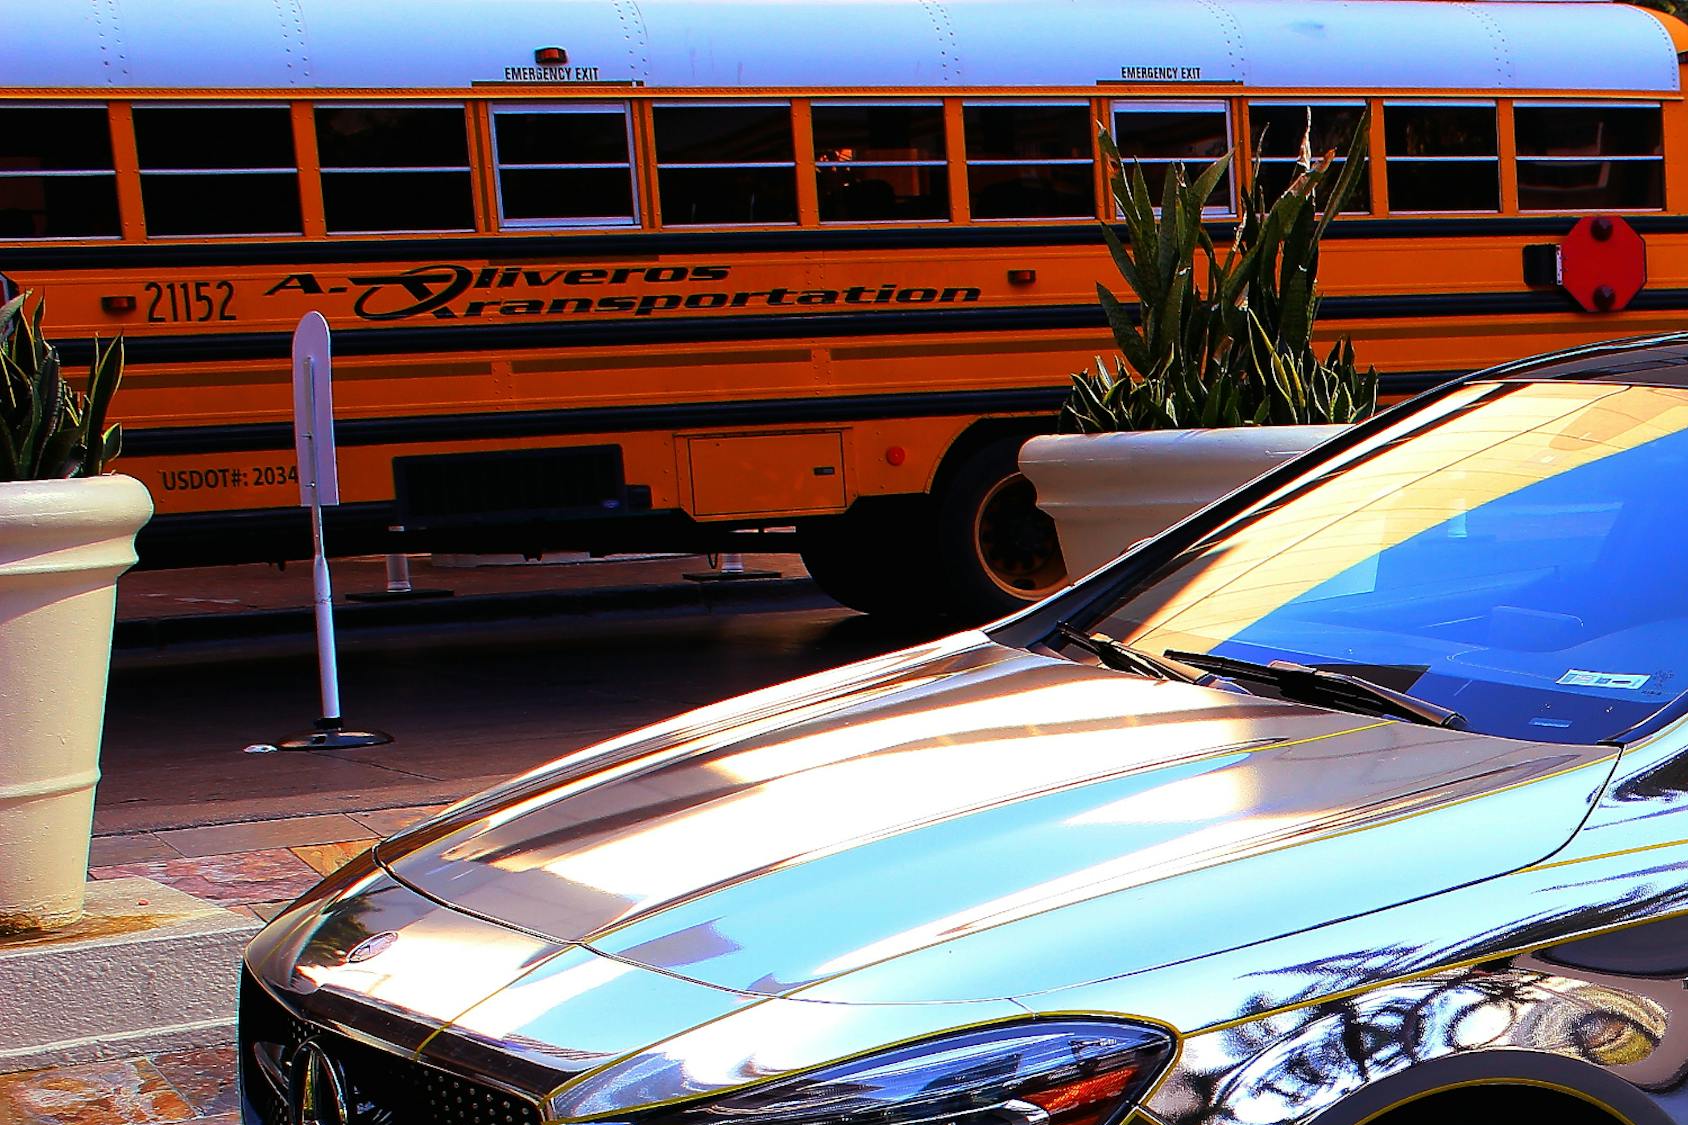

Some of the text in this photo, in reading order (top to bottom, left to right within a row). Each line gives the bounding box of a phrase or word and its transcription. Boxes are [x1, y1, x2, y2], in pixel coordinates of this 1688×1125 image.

[504, 67, 599, 81] EMERGENCY EXIT
[1121, 66, 1201, 79] EMERGENCY EXIT
[144, 281, 238, 323] 21152
[162, 468, 249, 491] USDOT#:
